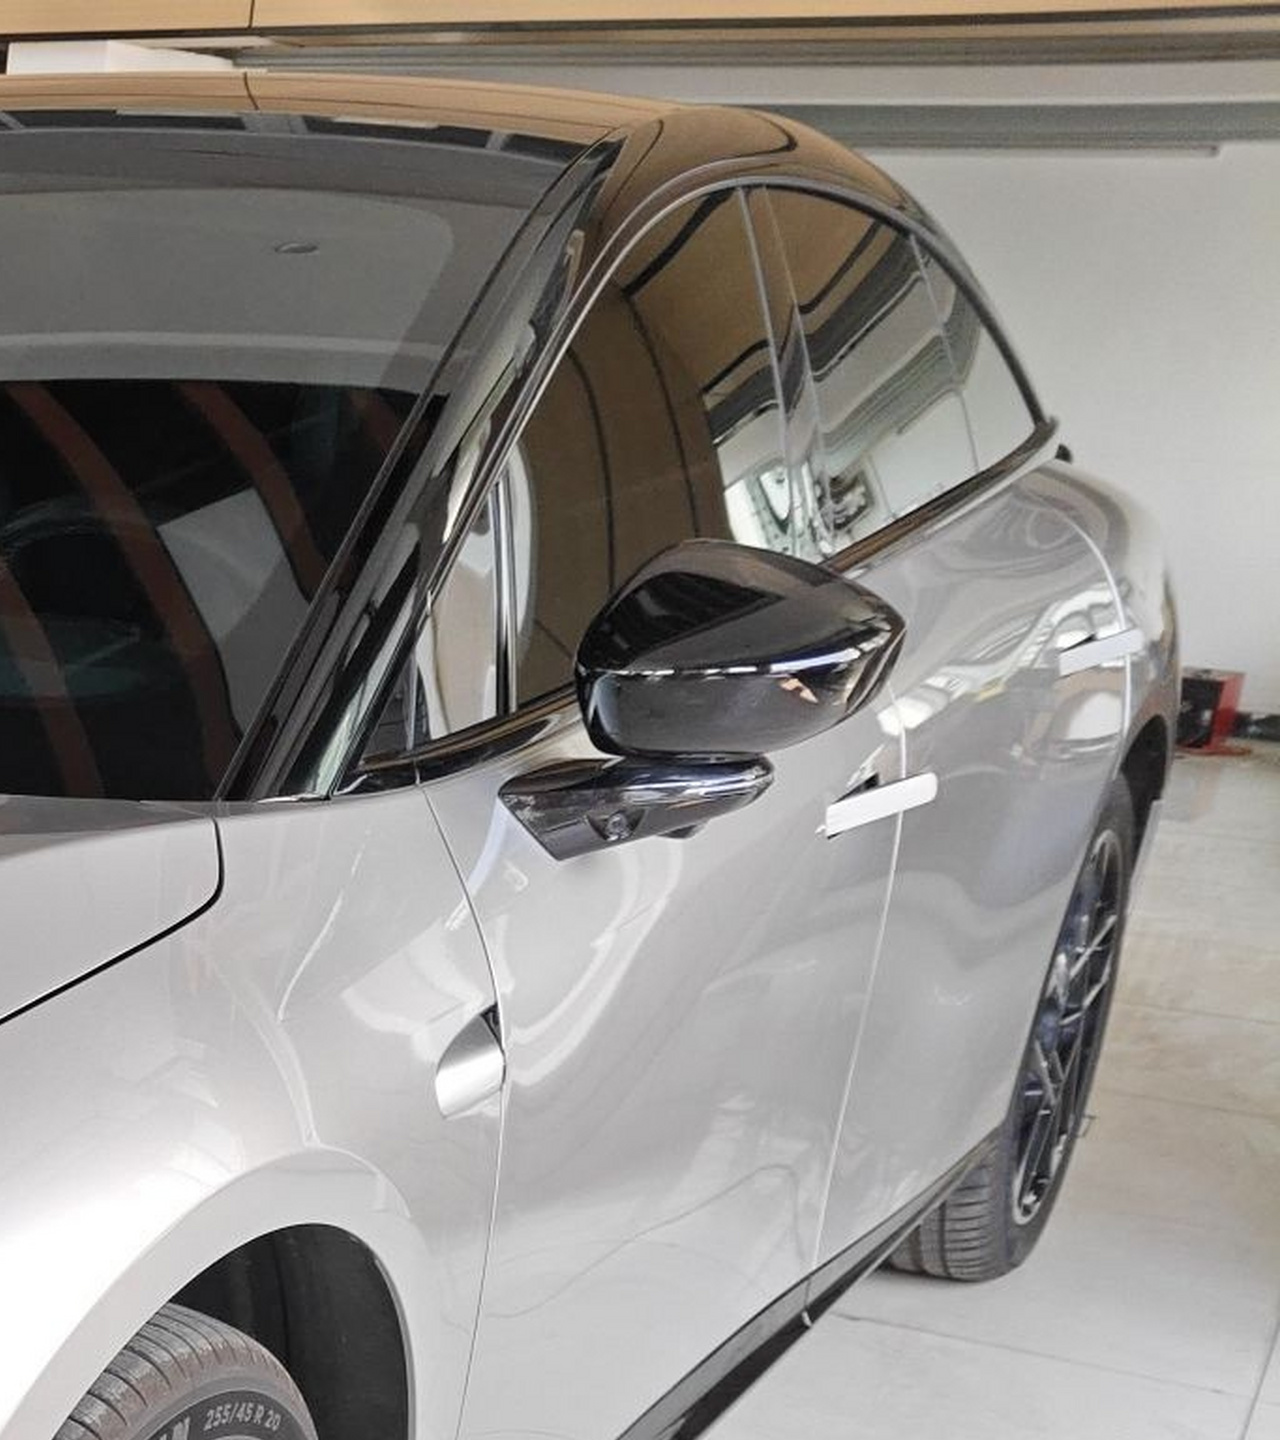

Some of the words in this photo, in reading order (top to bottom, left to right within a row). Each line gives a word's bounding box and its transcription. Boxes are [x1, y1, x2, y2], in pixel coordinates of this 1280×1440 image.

[203, 1402, 253, 1431] 255/45
[254, 1404, 265, 1424] R
[264, 1410, 282, 1431] 20
